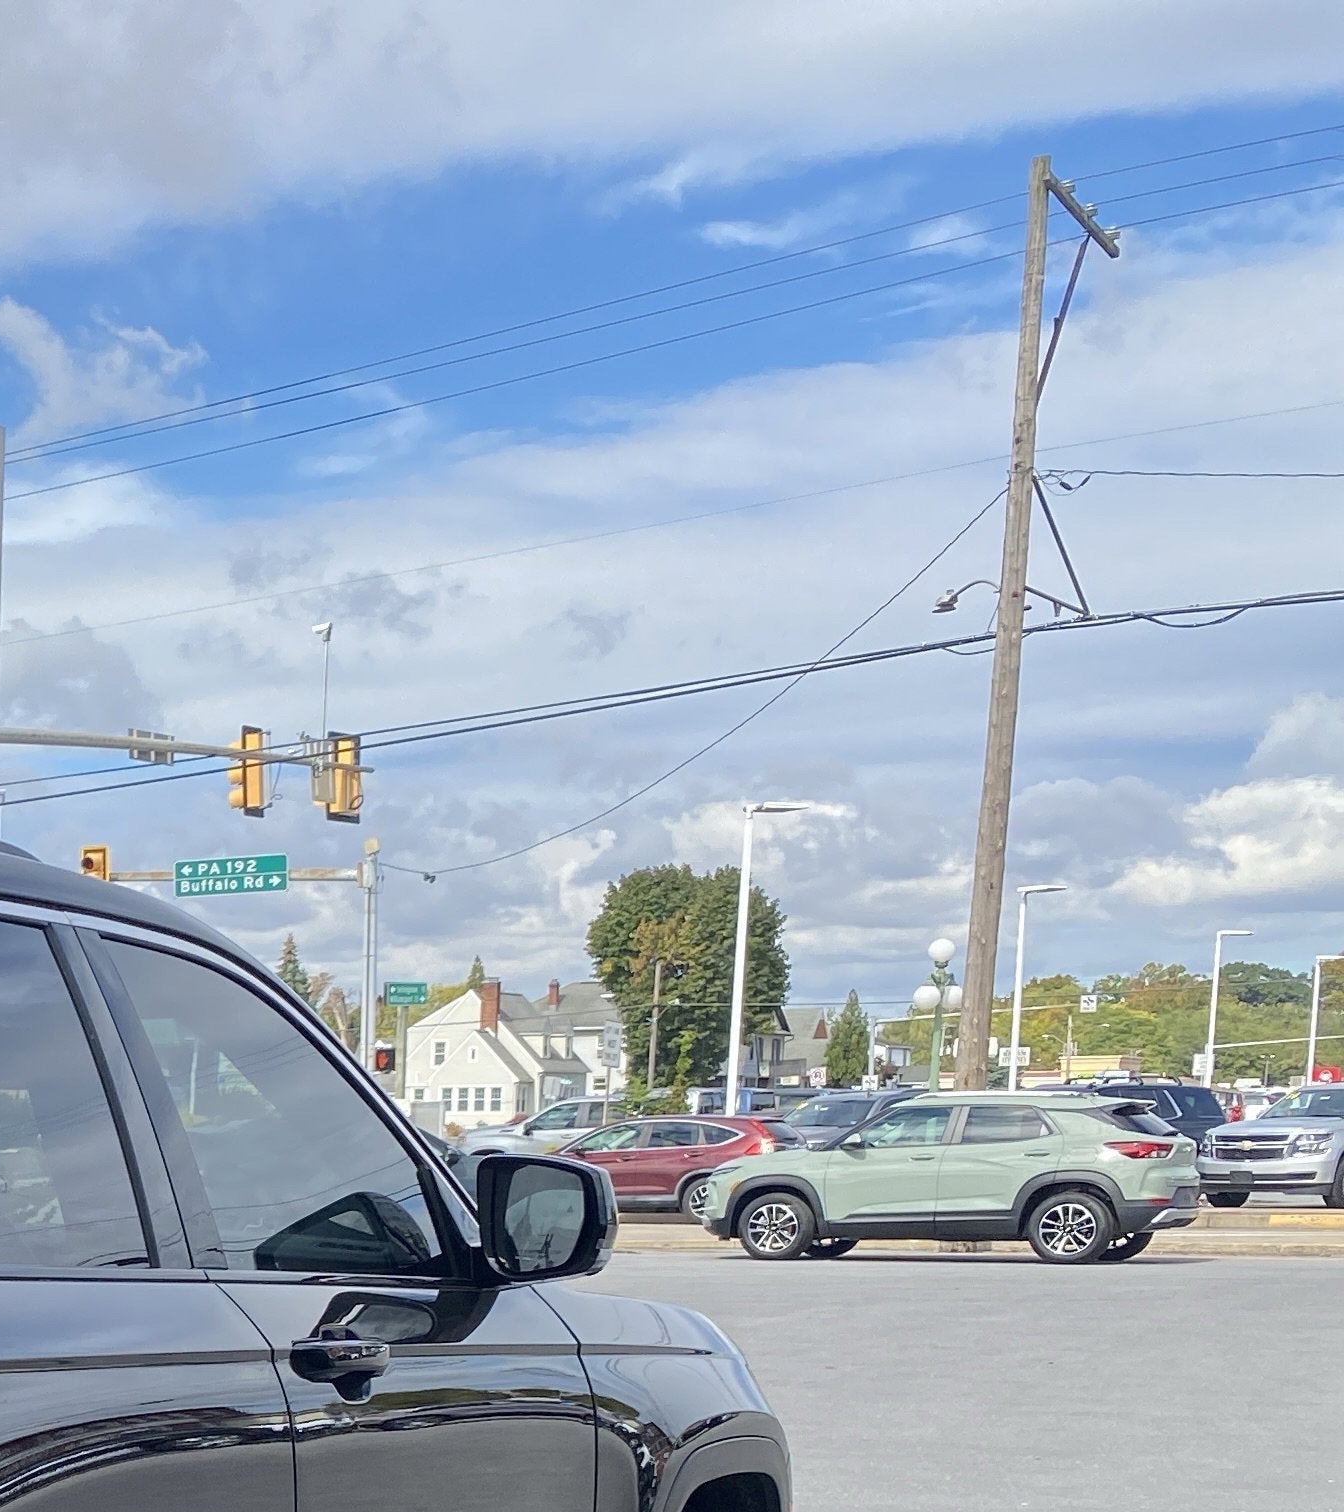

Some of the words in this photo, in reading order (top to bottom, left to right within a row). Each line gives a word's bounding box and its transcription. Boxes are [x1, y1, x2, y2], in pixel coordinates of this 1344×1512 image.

[197, 862, 221, 876] PA
[226, 859, 257, 874] 192
[180, 877, 238, 893] Buffalo
[243, 875, 264, 889] Rd
